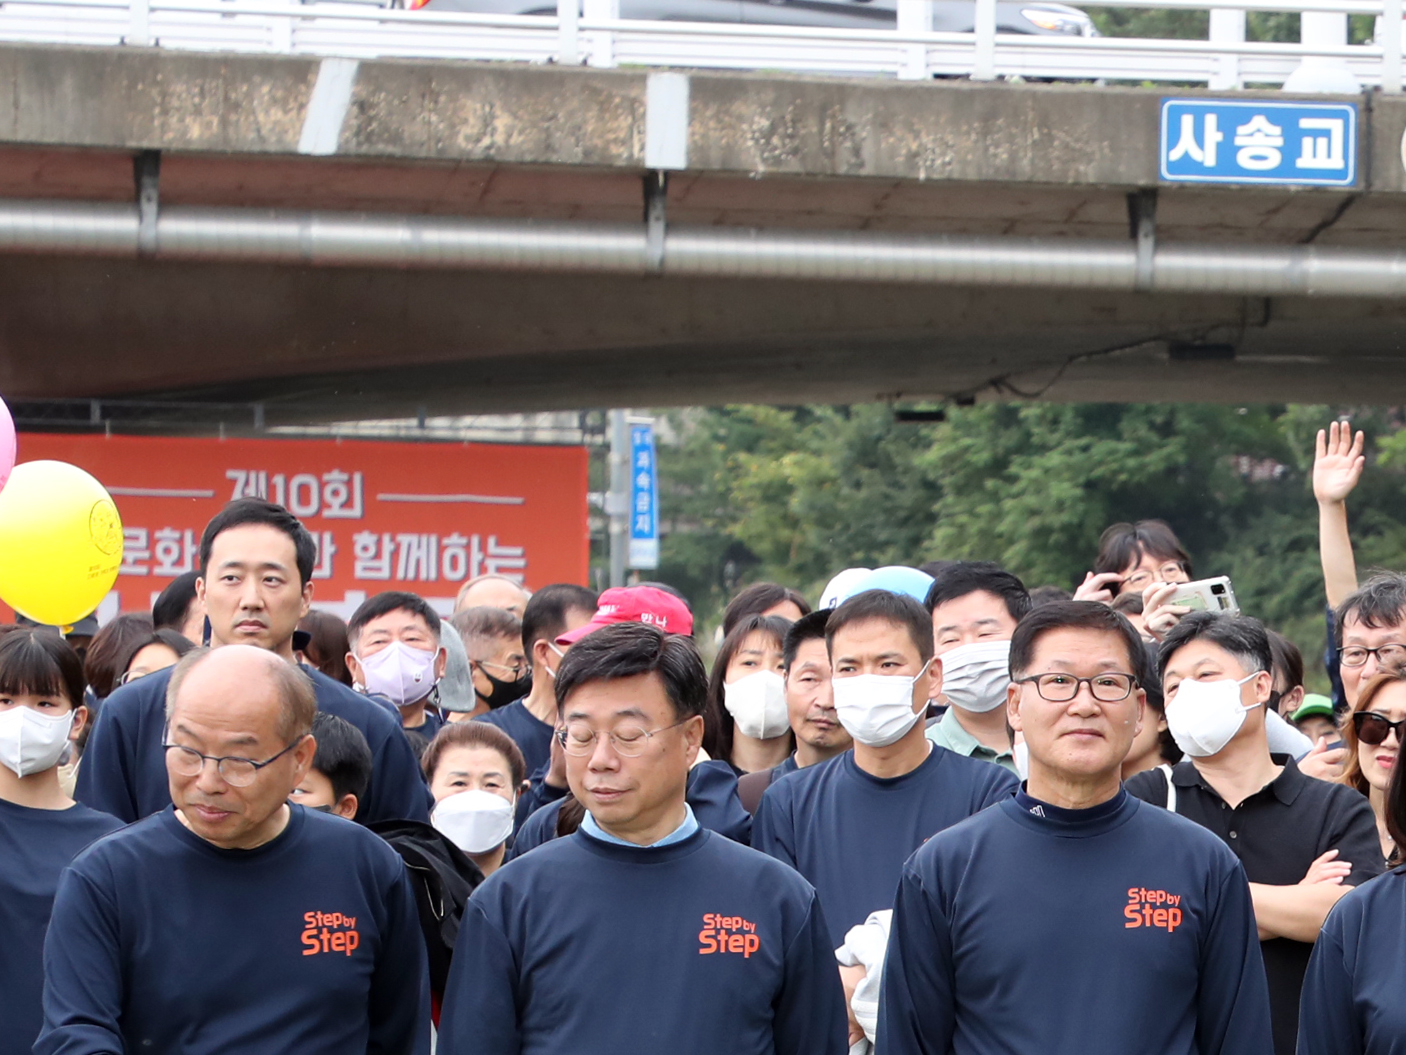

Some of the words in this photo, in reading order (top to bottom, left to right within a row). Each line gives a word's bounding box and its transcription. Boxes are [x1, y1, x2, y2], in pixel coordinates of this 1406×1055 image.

[1168, 112, 1345, 171] 사송교
[225, 468, 364, 519] 제10회
[353, 530, 527, 584] 함께하는
[1127, 887, 1167, 906] Step
[1166, 893, 1181, 907] by
[303, 910, 343, 929] Step
[342, 915, 357, 930] by
[702, 913, 743, 932] Step
[742, 919, 757, 934] by
[1124, 903, 1183, 933] Step
[300, 927, 360, 956] Step
[698, 929, 760, 959] Step
